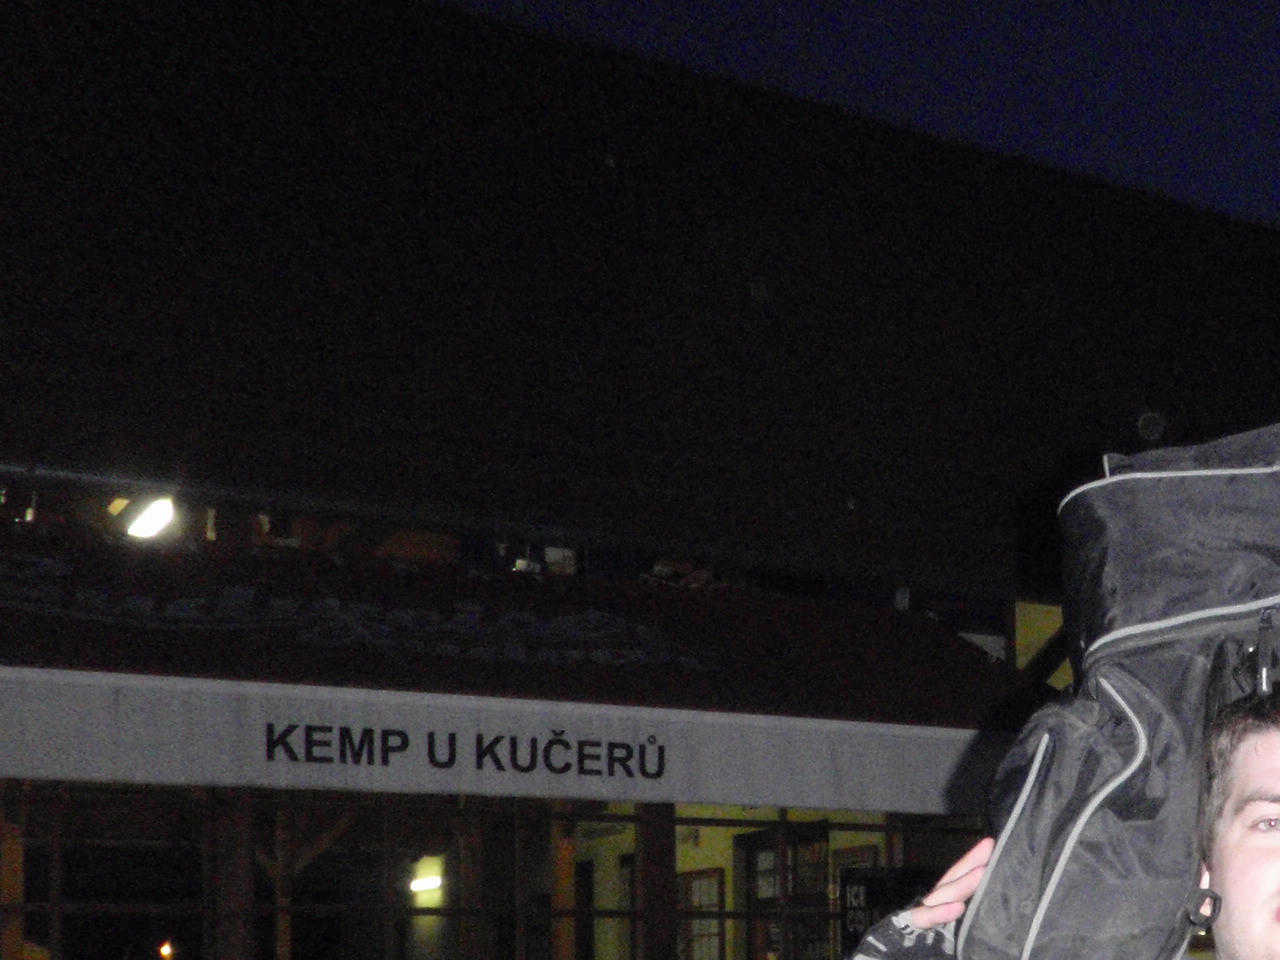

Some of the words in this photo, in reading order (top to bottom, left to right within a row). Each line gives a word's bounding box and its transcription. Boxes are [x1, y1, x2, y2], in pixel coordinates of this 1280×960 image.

[265, 722, 410, 767] KEMP
[426, 731, 457, 769] U
[475, 729, 667, 780] KUČERŮ
